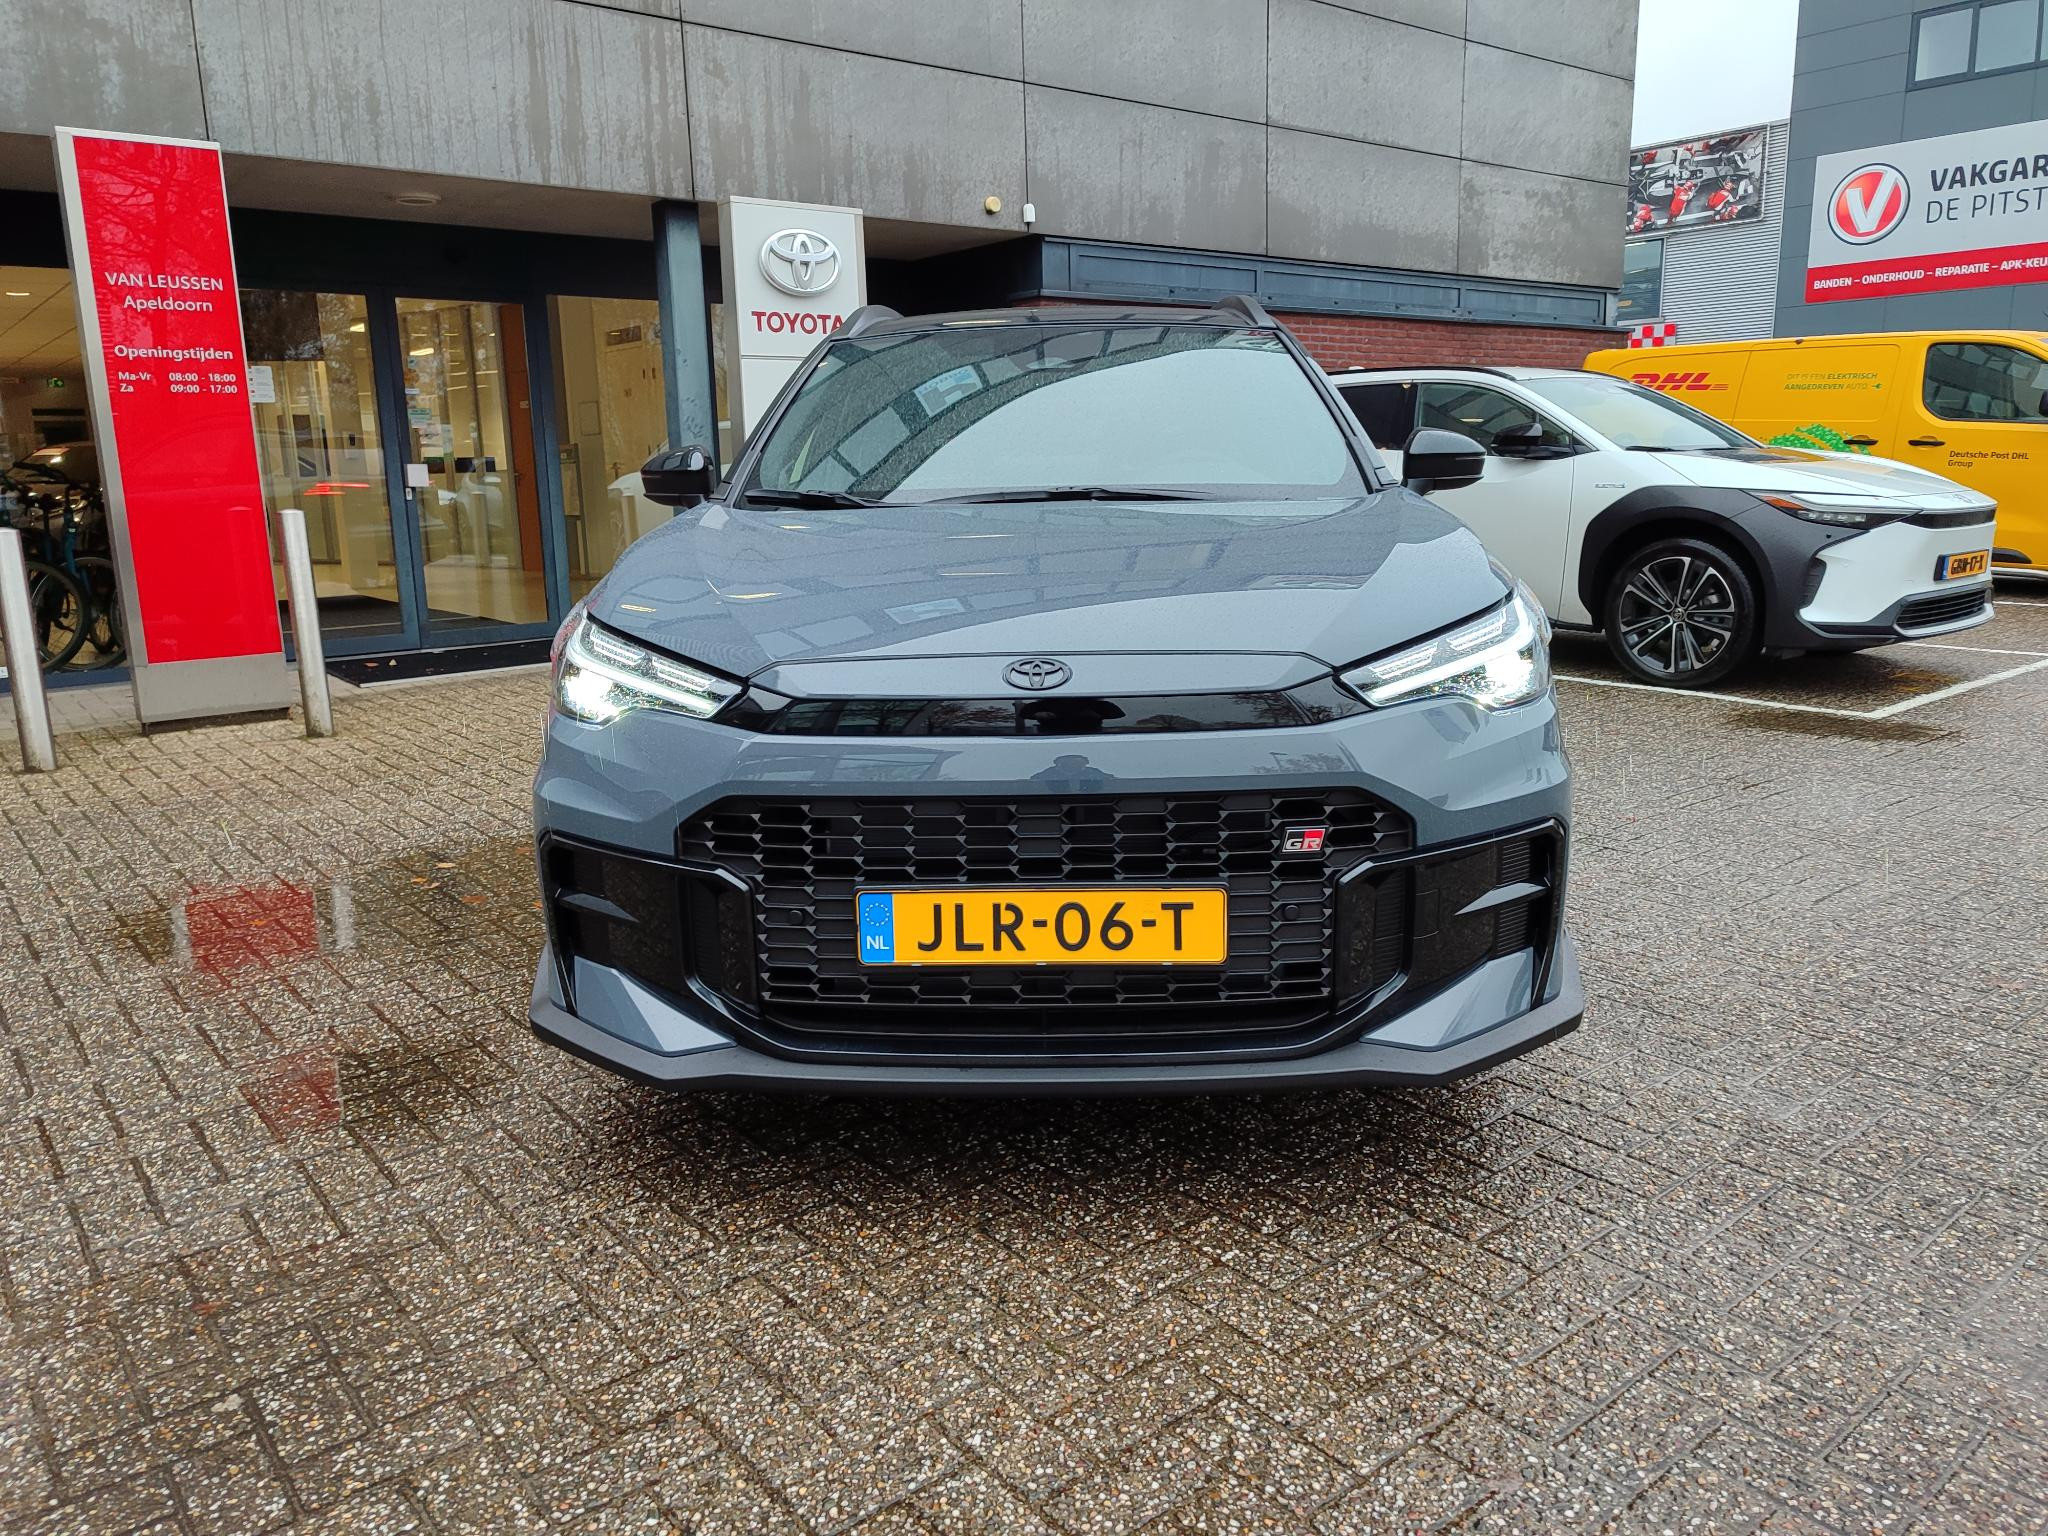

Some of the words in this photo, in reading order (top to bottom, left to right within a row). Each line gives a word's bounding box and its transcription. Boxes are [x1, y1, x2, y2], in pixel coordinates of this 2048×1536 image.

[1931, 154, 2048, 191] VAKGAR
[1926, 197, 1960, 223] DE
[1971, 186, 2048, 218] PITST
[105, 271, 143, 287] VAN
[147, 274, 223, 291] LEUSSEN
[1813, 277, 1852, 290] BANDEN
[1862, 269, 1924, 285] ONDERHOUD
[1935, 262, 1990, 277] REPARATIE
[2000, 256, 2048, 270] APK-KEU
[123, 295, 213, 312] Apeldoorn
[751, 311, 845, 335] TOYOTA
[114, 345, 233, 362] Openingstijden
[118, 371, 152, 381] Ma-Vr
[168, 372, 198, 382] 08:00
[208, 373, 236, 382] 18:00
[1630, 372, 1712, 391] DHL
[1827, 372, 1878, 380] ELEKTRISCH
[120, 383, 134, 393] Za
[170, 384, 200, 393] 09:00
[210, 385, 238, 394] 17:00
[1845, 382, 1868, 390] AUTO
[1949, 450, 1989, 459] Deutsche
[1991, 451, 2010, 460] Post
[2011, 452, 2030, 460] DHL
[1948, 460, 1973, 468] Group
[1285, 837, 1321, 850] GR
[917, 901, 1194, 952] JLR-06-T
[865, 934, 890, 950] NL
